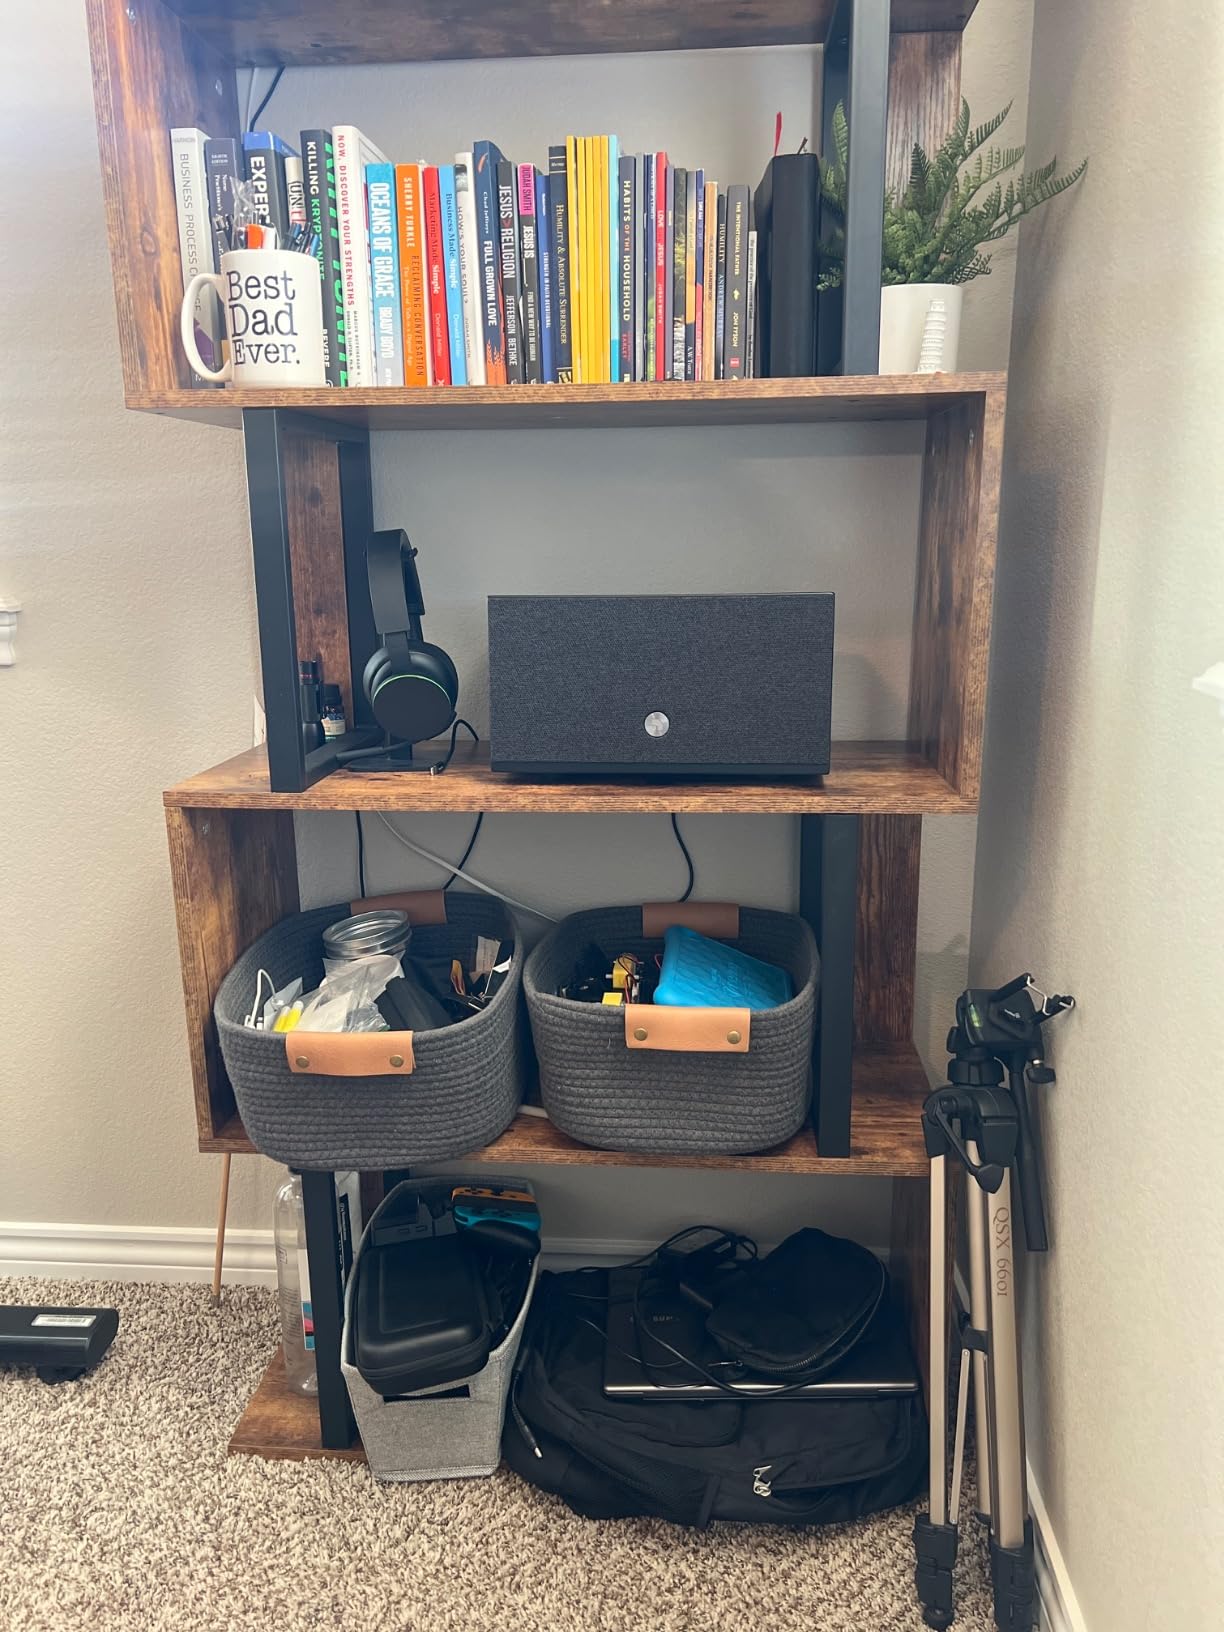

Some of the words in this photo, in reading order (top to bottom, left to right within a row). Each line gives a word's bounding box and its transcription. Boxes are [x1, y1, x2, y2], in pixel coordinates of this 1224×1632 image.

[338, 134, 346, 160] NOW,
[306, 141, 319, 195] KILLING
[522, 166, 532, 188] JUDAH
[340, 166, 350, 215] DISCOVER
[404, 177, 413, 211] SHERRY
[523, 189, 532, 211] SMITH
[180, 154, 192, 208] BUSINESS
[186, 214, 198, 264] PROCESS
[370, 182, 392, 234] OCEANS
[429, 192, 438, 238] Marketing
[446, 193, 455, 232] Business
[556, 204, 565, 244] HUMILITY
[342, 219, 352, 245] YOUR
[374, 236, 392, 253] OF
[405, 215, 415, 248] TURKLE
[448, 233, 456, 257] Made
[523, 225, 534, 248] JESUS
[624, 225, 630, 234] OF
[430, 240, 438, 263] Made
[483, 240, 494, 264] FULL
[557, 246, 565, 254] &
[226, 270, 296, 302] Best
[344, 250, 354, 306] STRENGTHS
[374, 256, 394, 298] GRACE
[412, 256, 421, 308] RECLAIMING
[485, 267, 495, 300] GROWN
[558, 257, 567, 297] ABSOLUTE
[623, 255, 631, 321] HOUSEHOLD
[228, 302, 298, 338] Dad
[379, 306, 393, 334] BRADY
[434, 313, 442, 337] Donald
[453, 314, 461, 338] Donald
[486, 302, 496, 326] LOVE
[506, 295, 516, 334] JEFFERSON
[559, 299, 568, 344] SURRENDER
[232, 338, 300, 366] Ever.
[380, 336, 394, 358] BOYD
[414, 312, 424, 376] CONVERSATION
[508, 338, 518, 366] BETHKE
[993, 1207, 1009, 1248] QSX
[996, 1258, 1011, 1296] 6601
